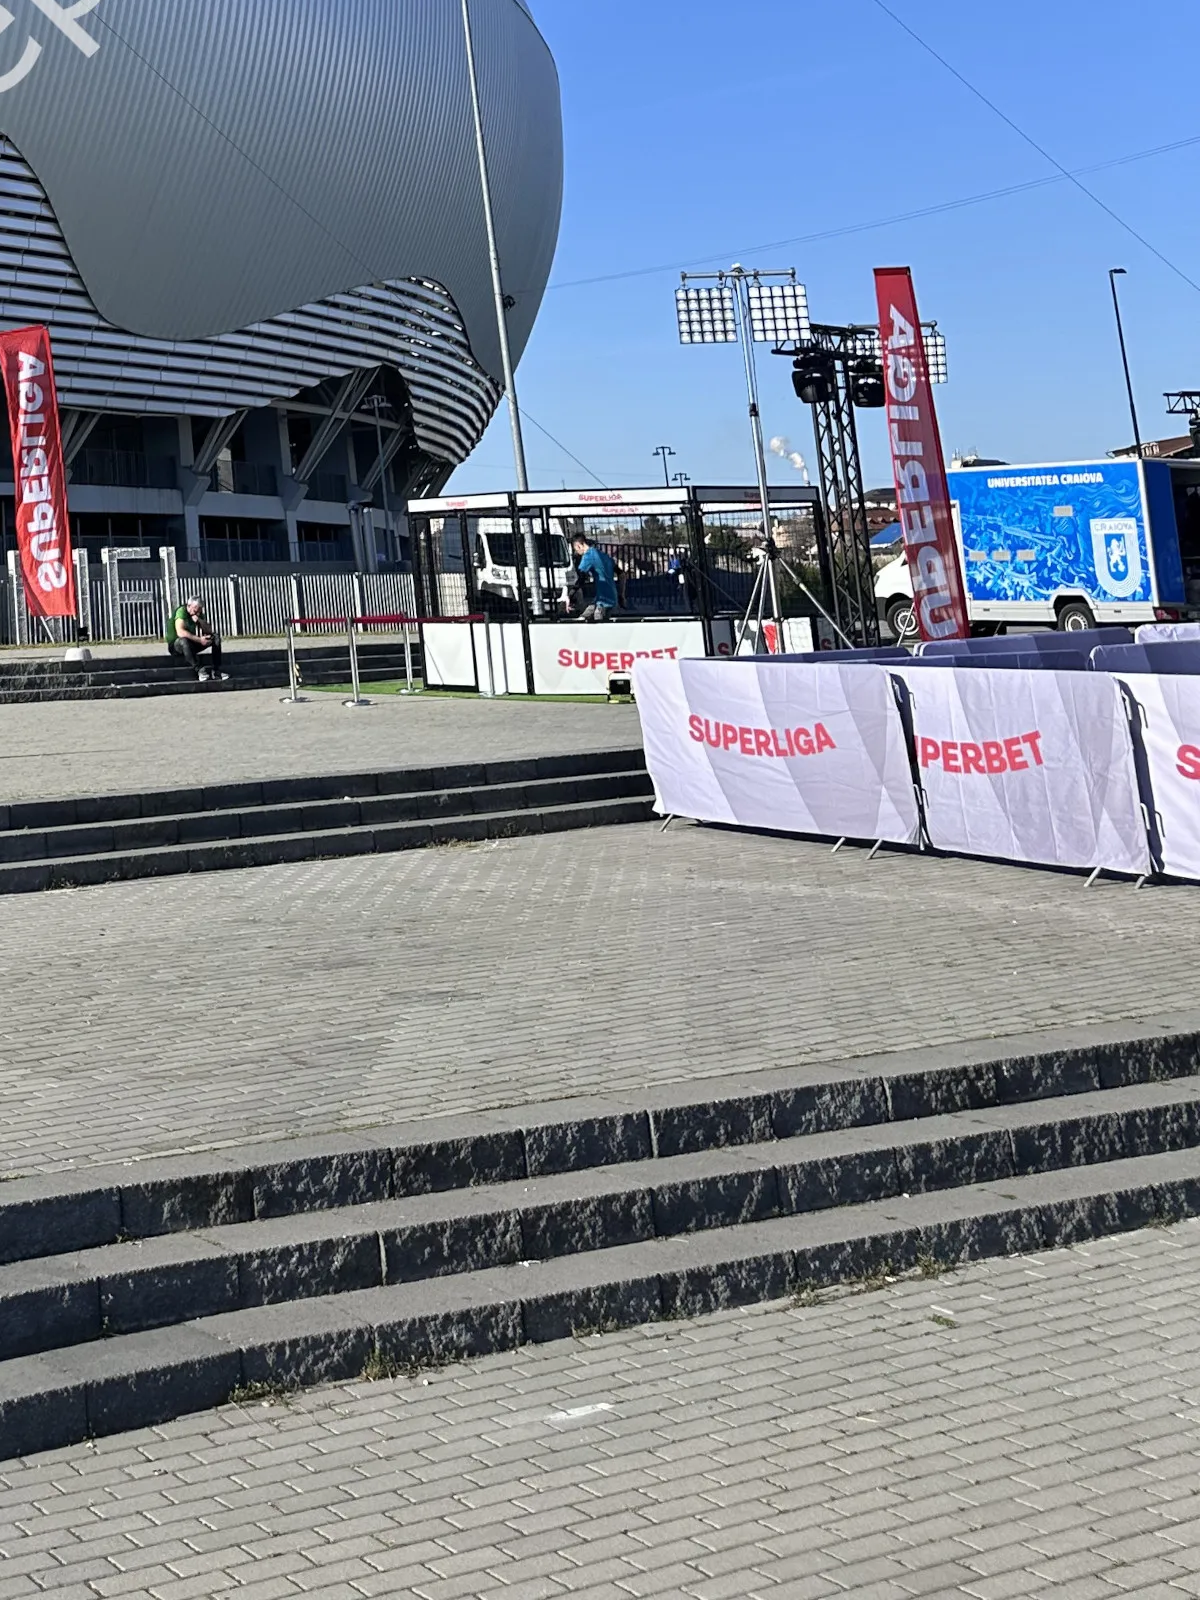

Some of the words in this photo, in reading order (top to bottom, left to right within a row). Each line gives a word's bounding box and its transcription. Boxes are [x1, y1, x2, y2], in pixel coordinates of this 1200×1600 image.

[987, 474, 1060, 489] UNIVERSITATEA
[1060, 472, 1104, 485] CRAIOVA
[688, 714, 837, 758] SUPERLIGA
[914, 730, 1044, 775] PERBET
